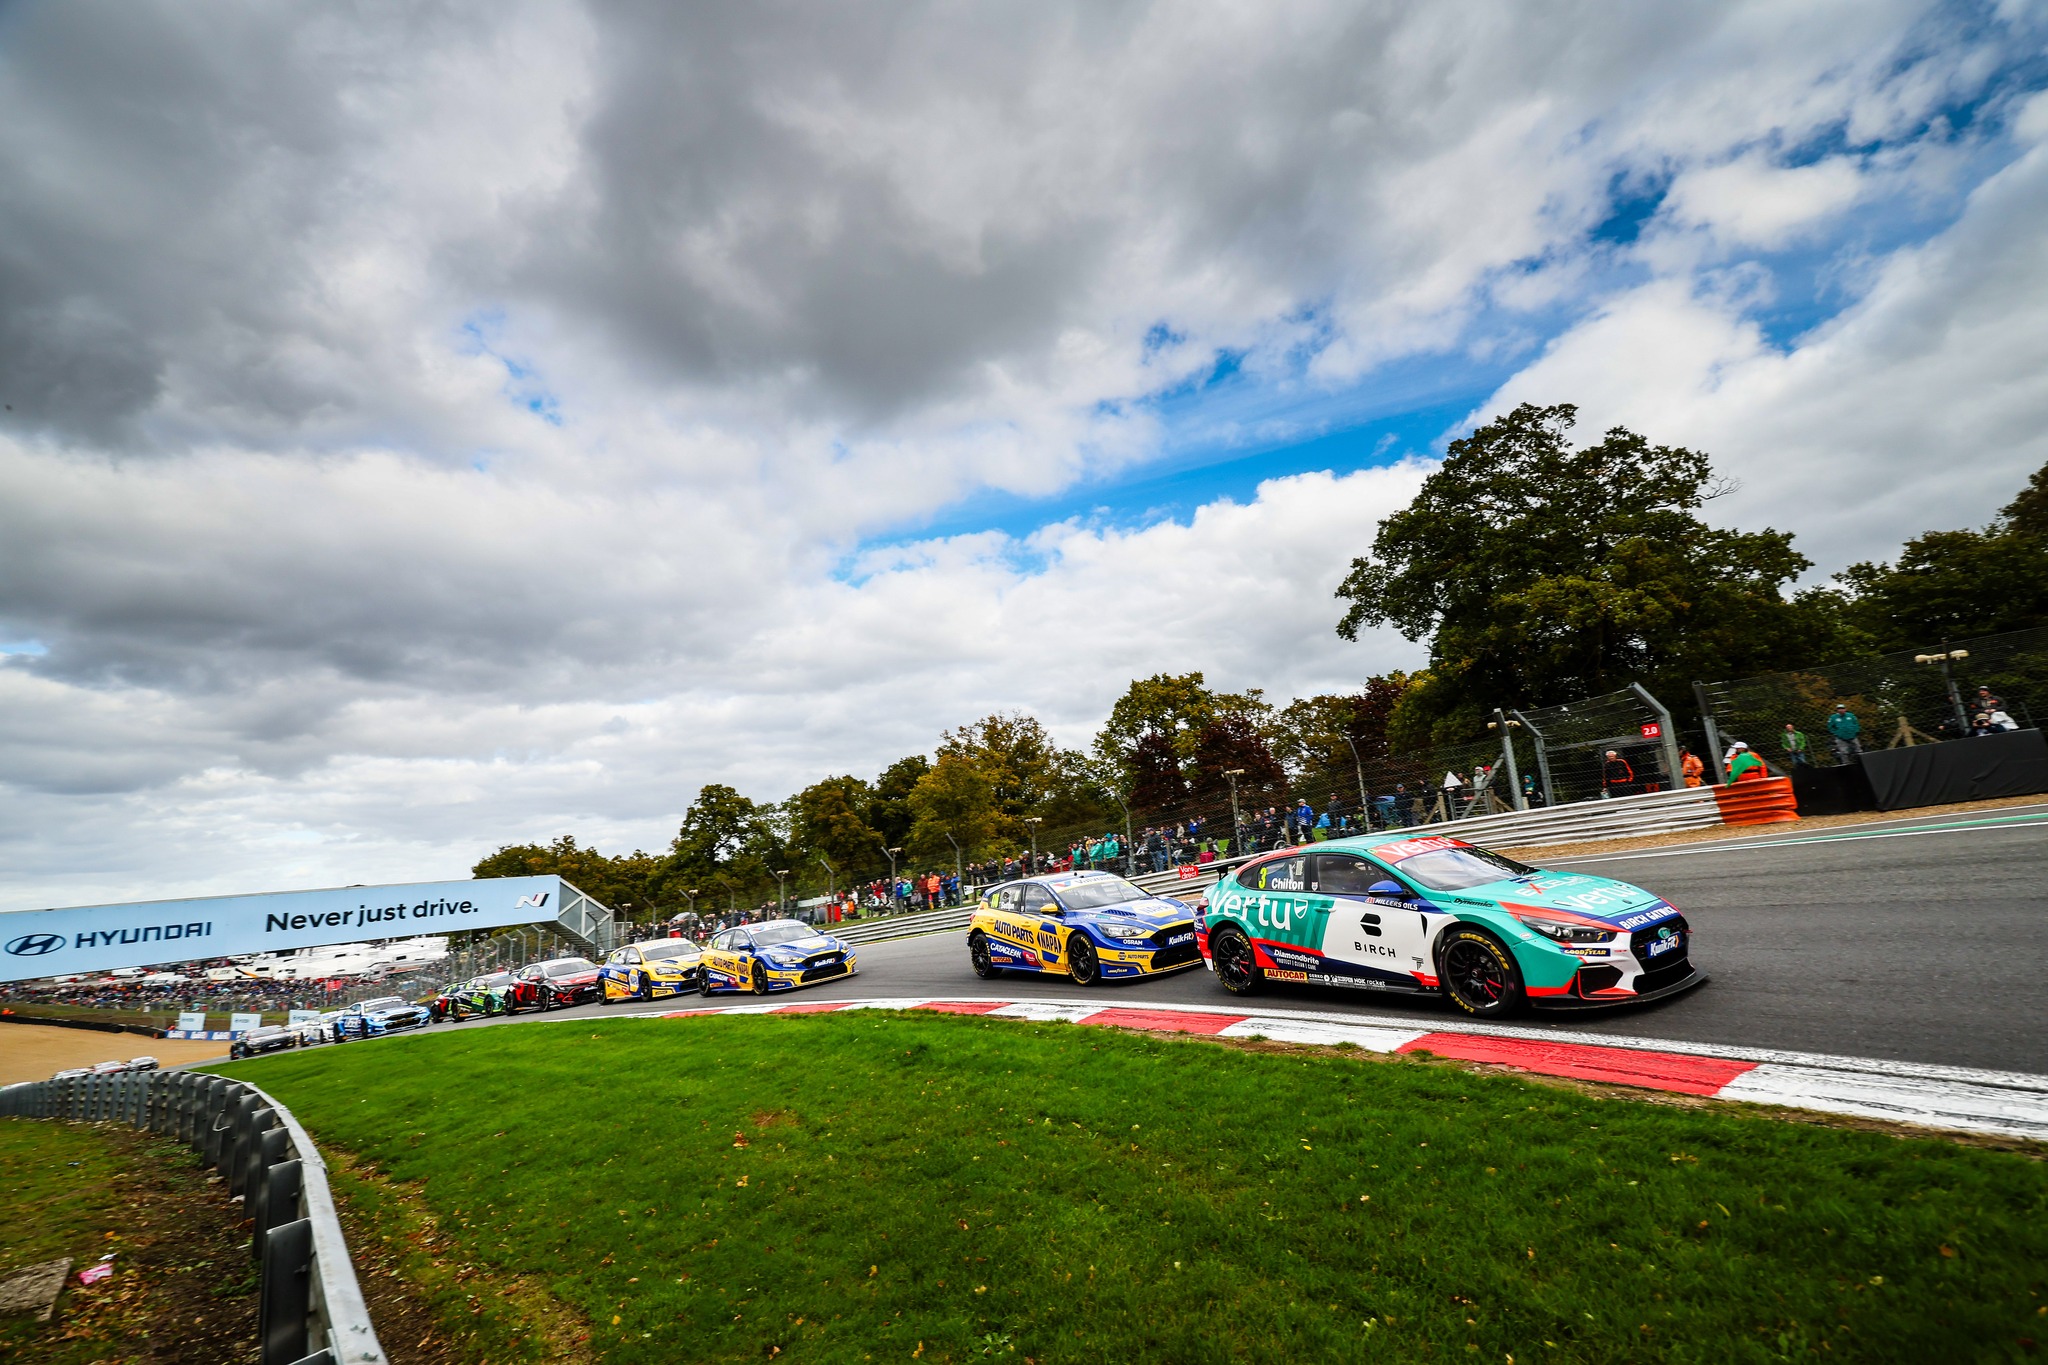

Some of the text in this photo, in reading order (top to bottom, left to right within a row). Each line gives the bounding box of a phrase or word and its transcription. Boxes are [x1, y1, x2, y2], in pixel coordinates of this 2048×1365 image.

[1643, 726, 1658, 736] 2.0
[1181, 871, 1197, 880] direct
[1258, 867, 1268, 889] 3
[1271, 877, 1304, 891] Chilton
[1374, 898, 1419, 911] MILLERS OILS
[1453, 897, 1495, 908] Dynamics
[265, 898, 479, 932] Never just drive.
[1619, 914, 1649, 930] BIRCH
[75, 921, 212, 949] HYUNDAI
[993, 920, 1035, 944] AUTO PARTS
[1039, 932, 1060, 953] NAPA
[1354, 941, 1397, 958] BIRCH
[990, 943, 1022, 959] CATACLEAN
[1274, 949, 1320, 965] Diamondbrite
[1563, 948, 1607, 956] GOODYEAR
[1267, 969, 1305, 980] AUTOCAR
[1366, 979, 1386, 988] rocket
